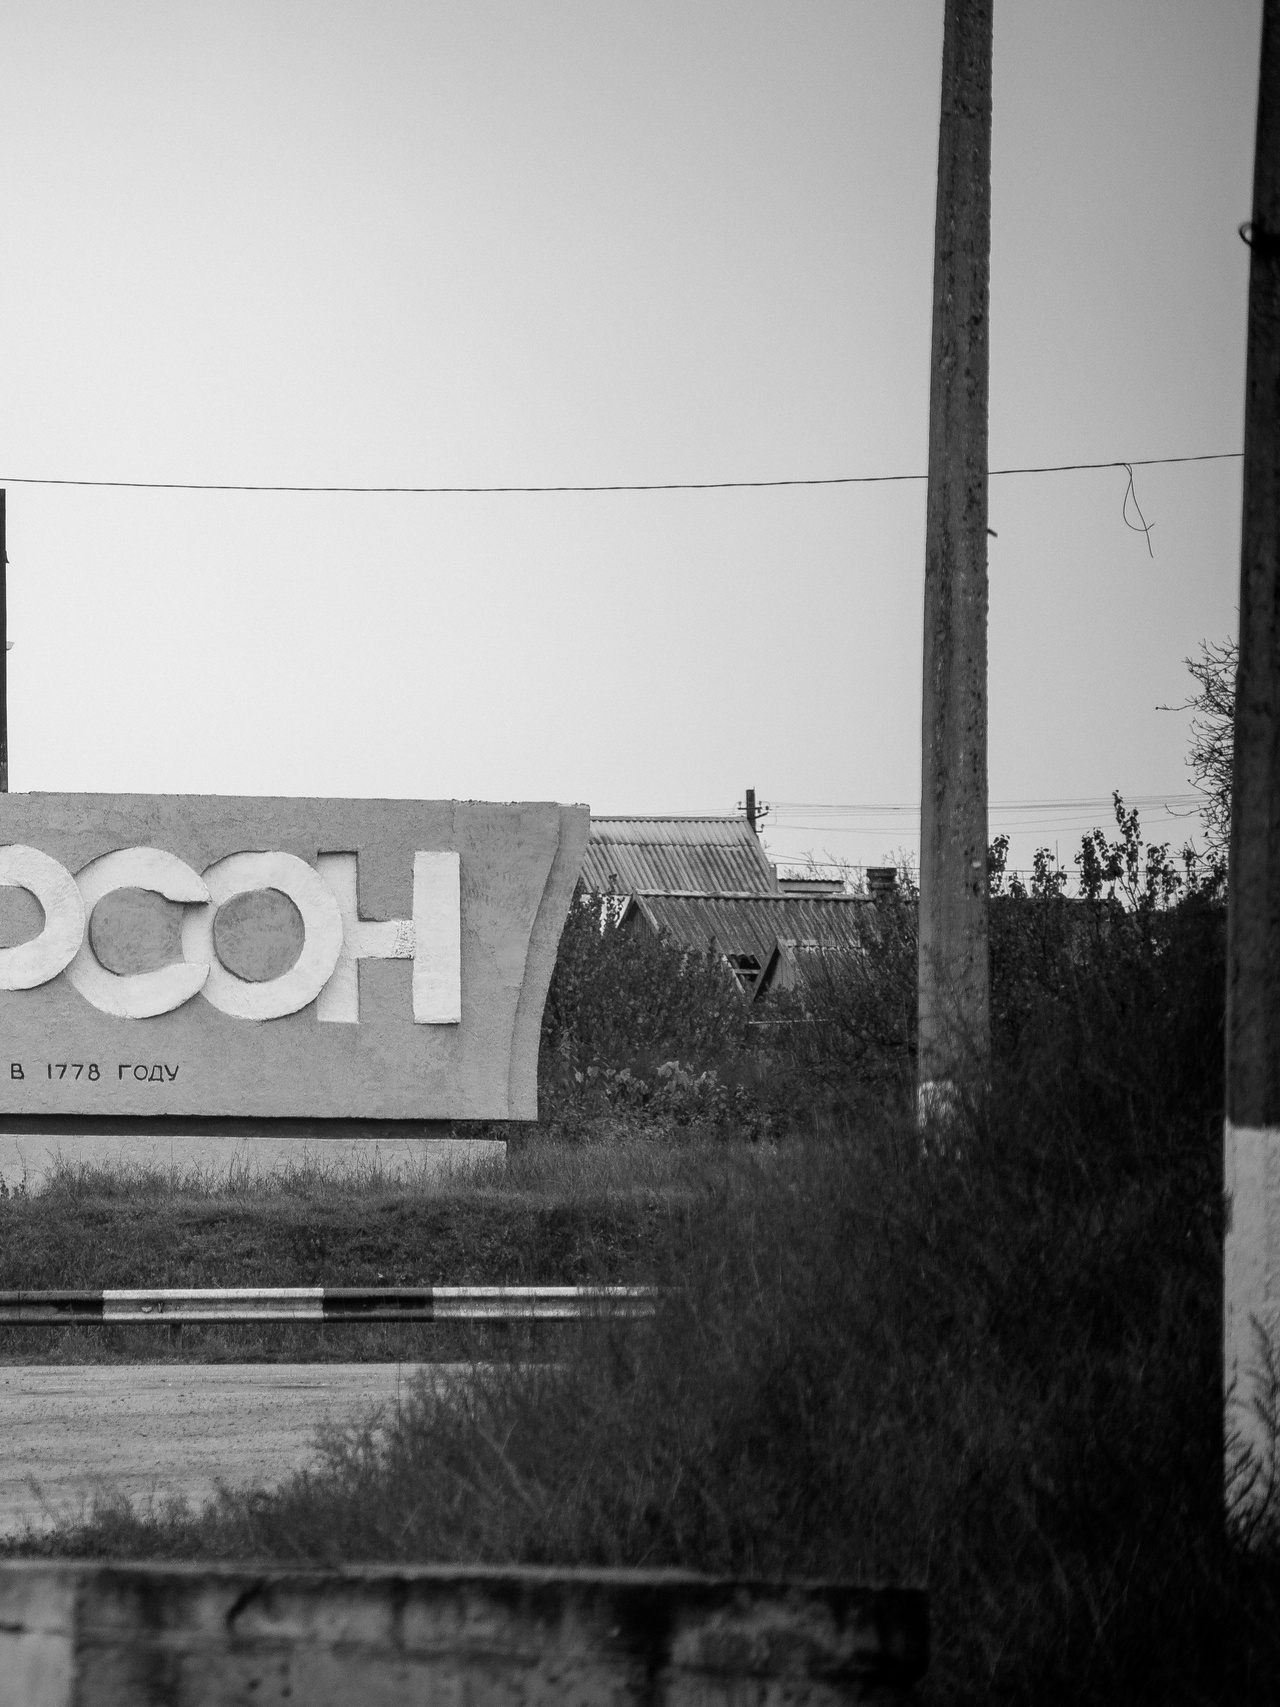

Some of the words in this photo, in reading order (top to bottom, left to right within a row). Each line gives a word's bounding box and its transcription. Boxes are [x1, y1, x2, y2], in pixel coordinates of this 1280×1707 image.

[11, 1062, 25, 1080] В
[48, 1062, 101, 1081] 1778
[118, 1064, 179, 1082] ГОДУ
